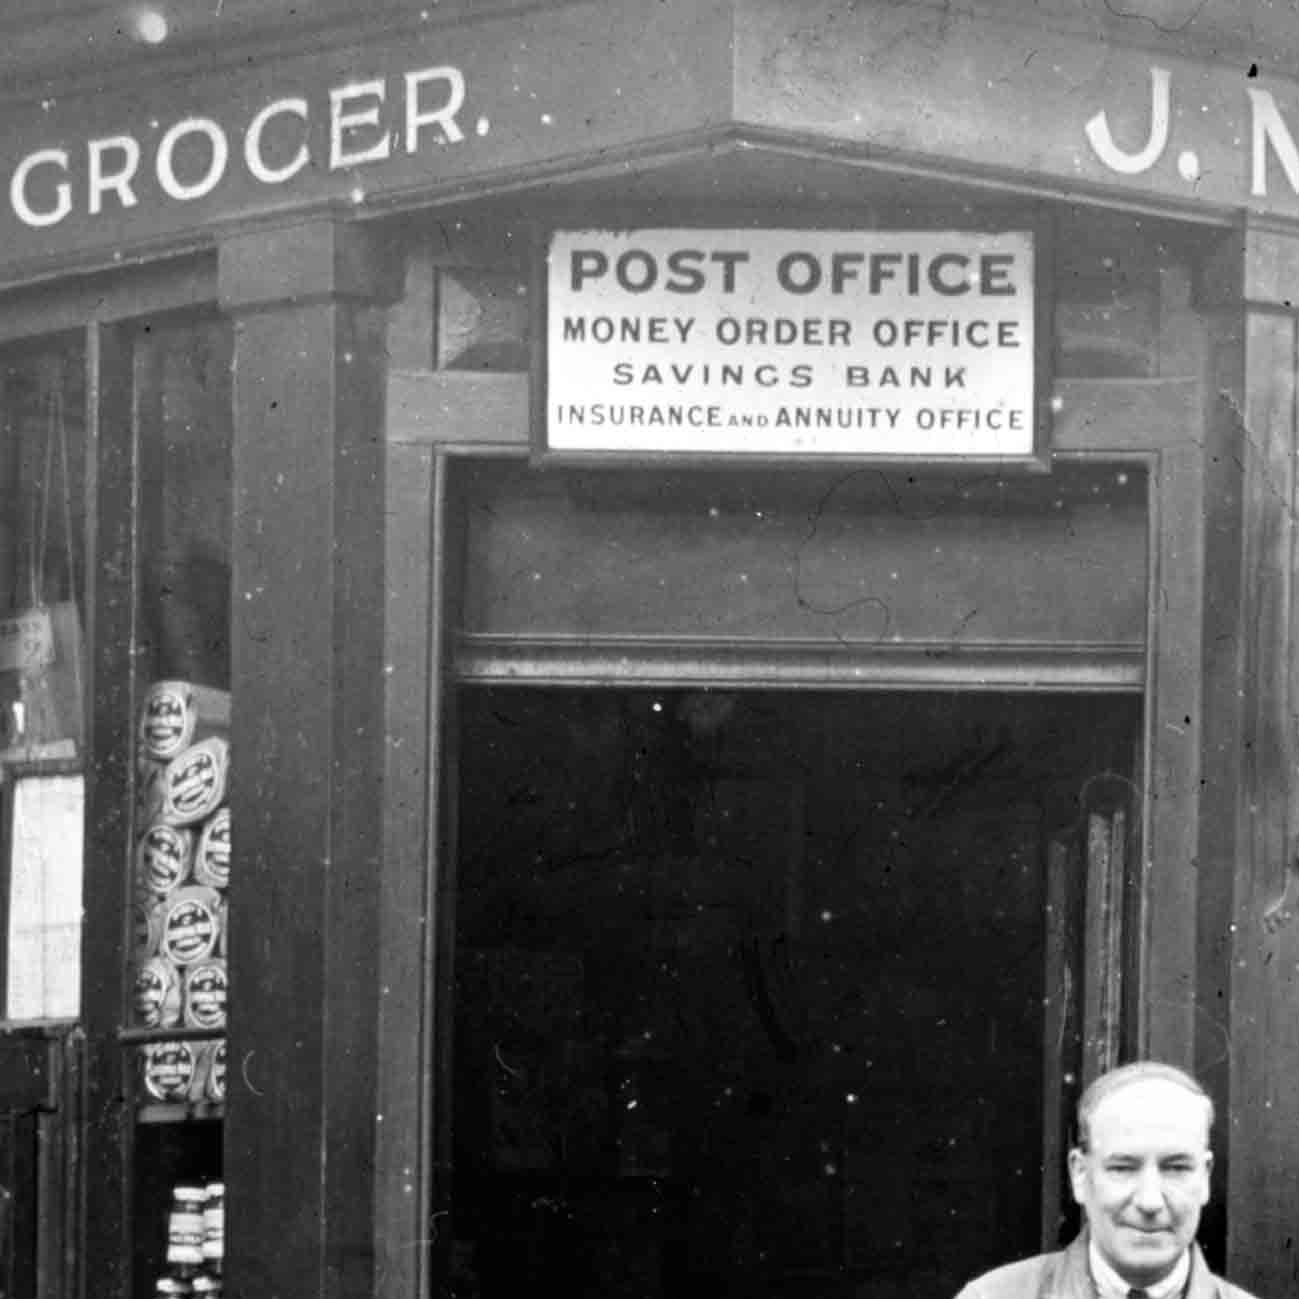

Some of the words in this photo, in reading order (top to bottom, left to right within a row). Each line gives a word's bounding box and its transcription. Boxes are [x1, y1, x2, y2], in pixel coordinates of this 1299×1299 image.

[1083, 66, 1202, 183] J.
[9, 65, 491, 228] GROCER.
[569, 248, 751, 295] POST
[776, 250, 1018, 297] OFFICE
[562, 315, 696, 345] MONEY
[715, 316, 853, 347] ORDER
[872, 317, 1021, 349] OFFICE
[612, 362, 814, 388] SAVINGS
[845, 364, 967, 389] BANK
[556, 403, 722, 428] INSURANCE
[727, 413, 769, 429] AND
[774, 406, 901, 430] ANNUITY
[915, 406, 1025, 432] OFFICE
